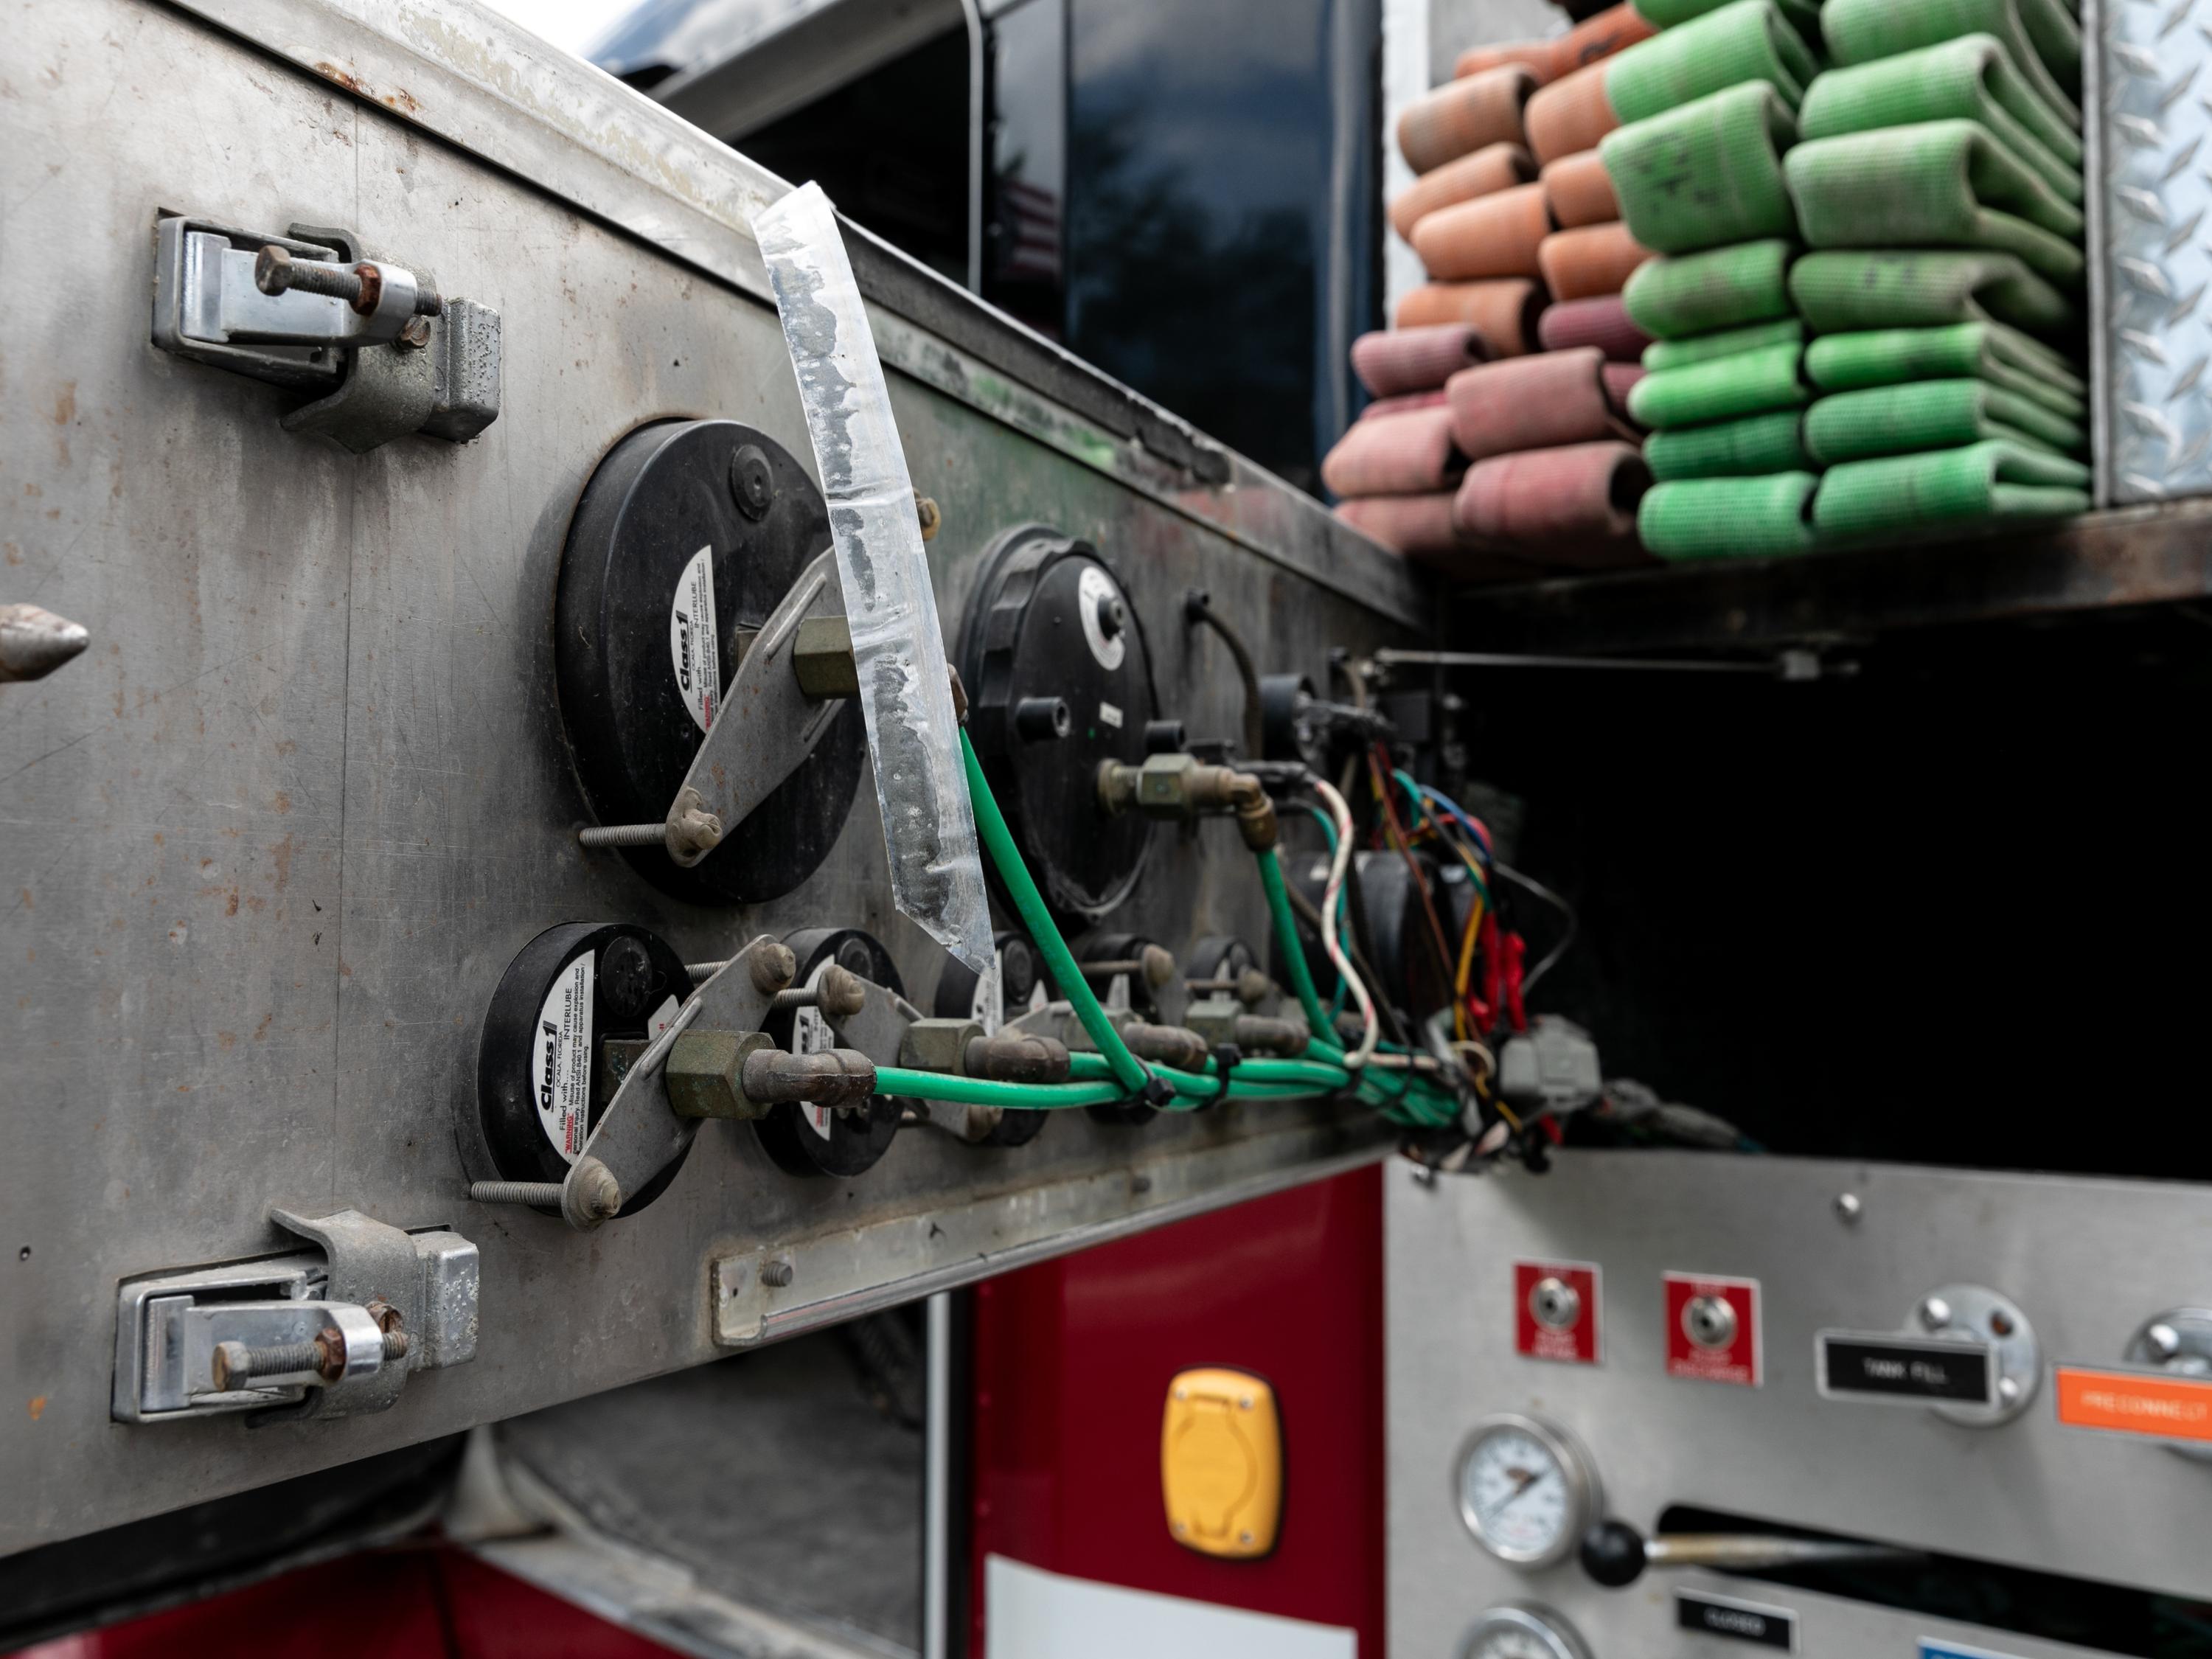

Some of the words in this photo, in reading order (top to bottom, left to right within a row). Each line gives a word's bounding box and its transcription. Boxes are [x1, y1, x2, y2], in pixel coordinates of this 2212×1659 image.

[691, 581, 699, 628] INTERLUBE
[564, 988, 572, 1040] INTERLUBE
[1863, 1358, 1906, 1380] TANK
[1910, 1363, 1949, 1384] FILL
